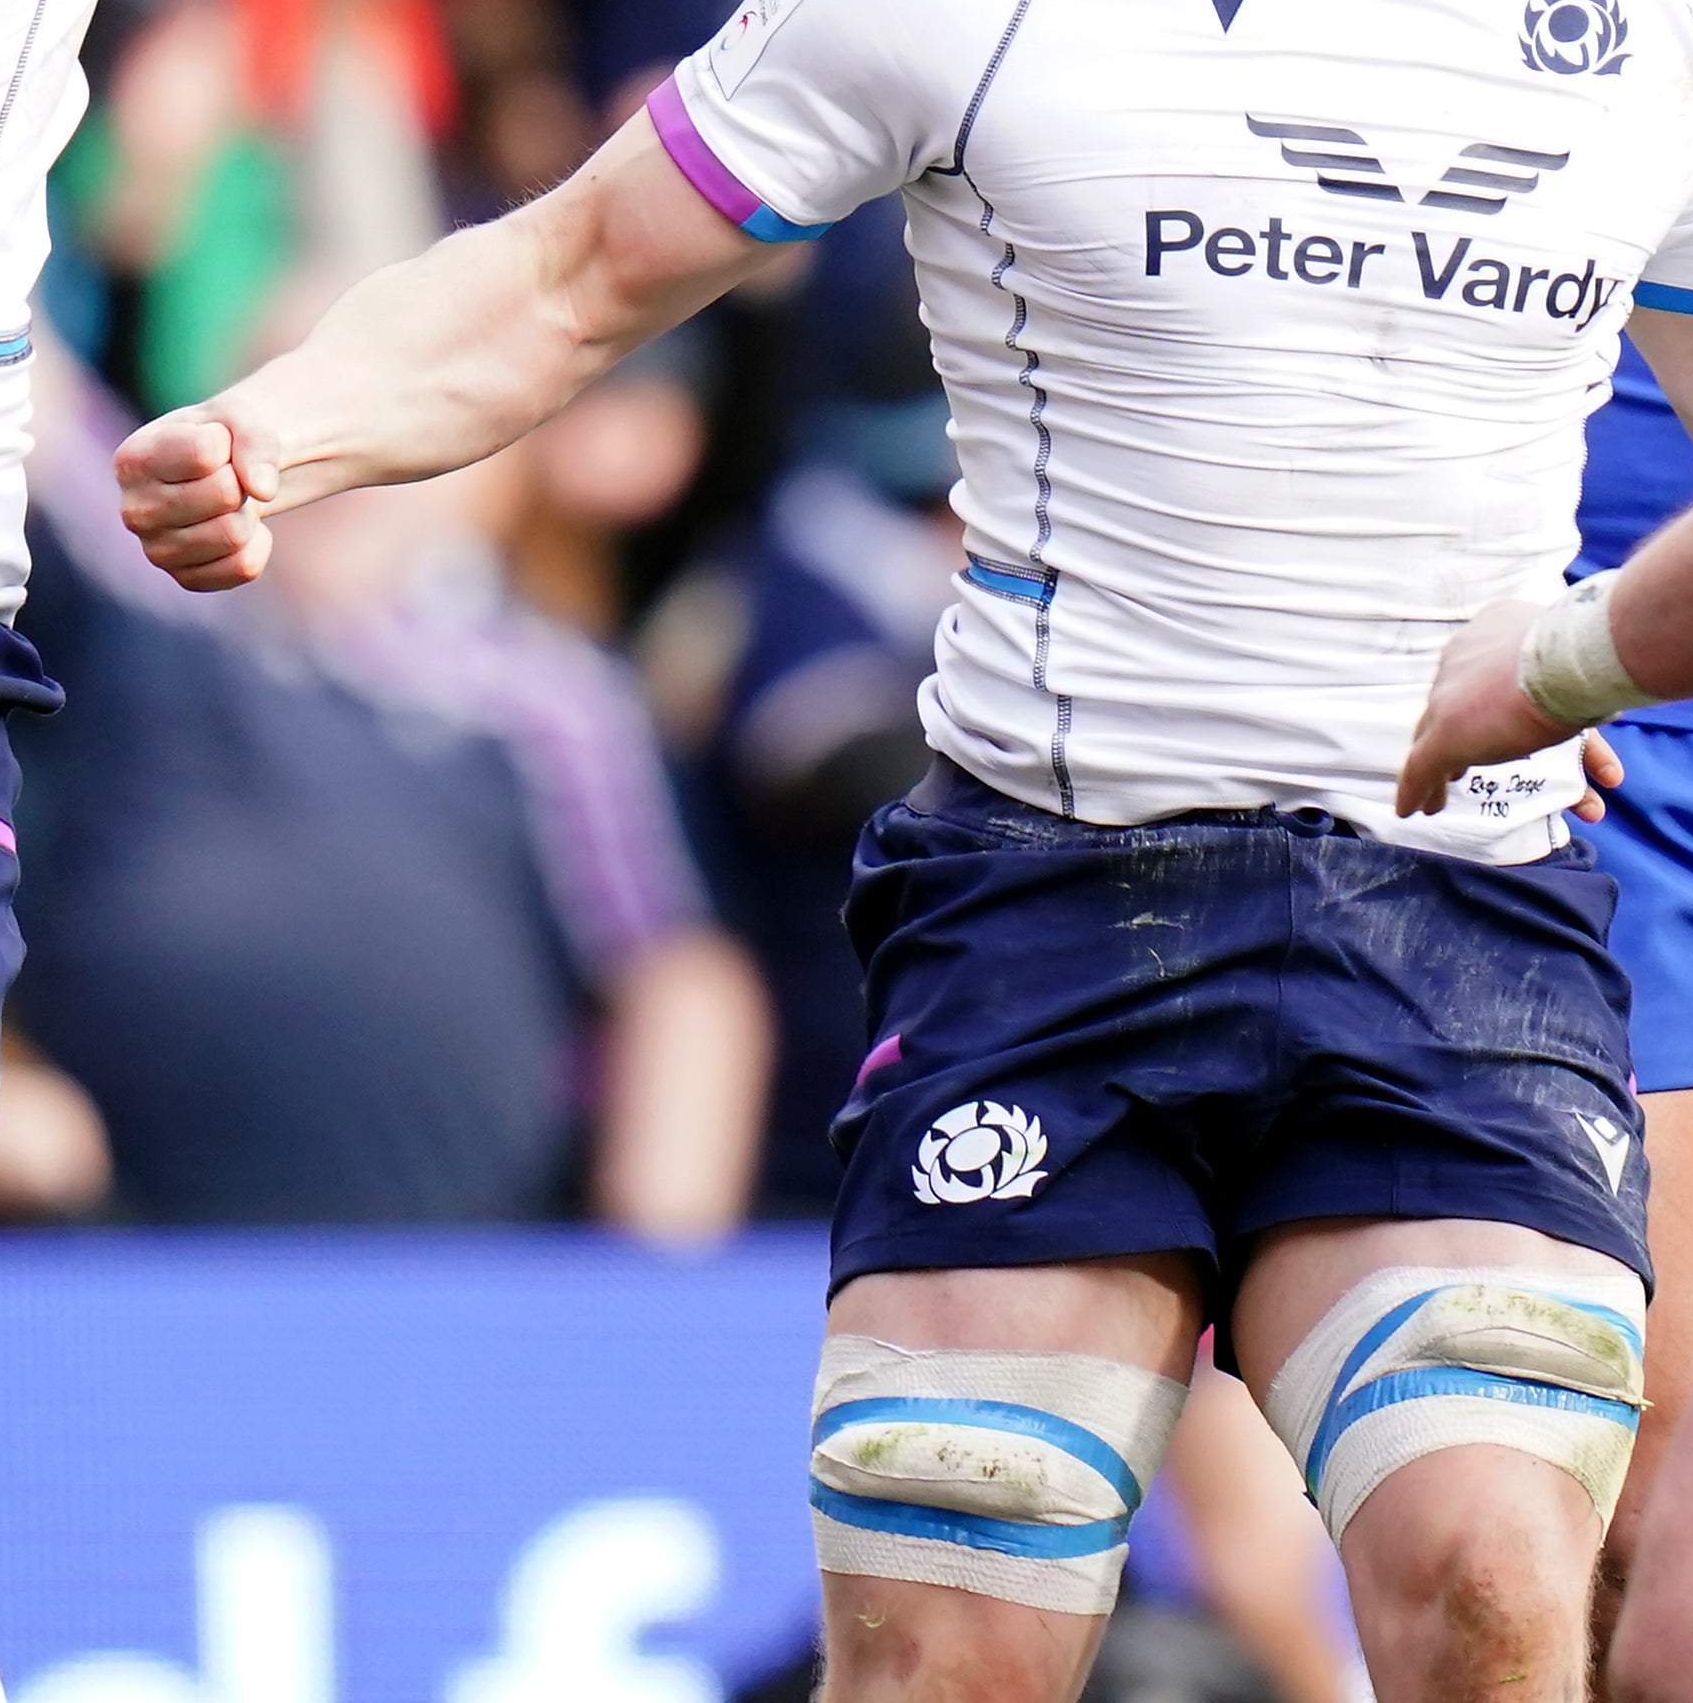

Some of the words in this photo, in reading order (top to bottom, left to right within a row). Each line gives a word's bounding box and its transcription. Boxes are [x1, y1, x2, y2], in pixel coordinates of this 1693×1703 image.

[1144, 208, 1385, 290] Peter
[1410, 230, 1621, 334] Vardy
[1480, 801, 1510, 818] 1130
